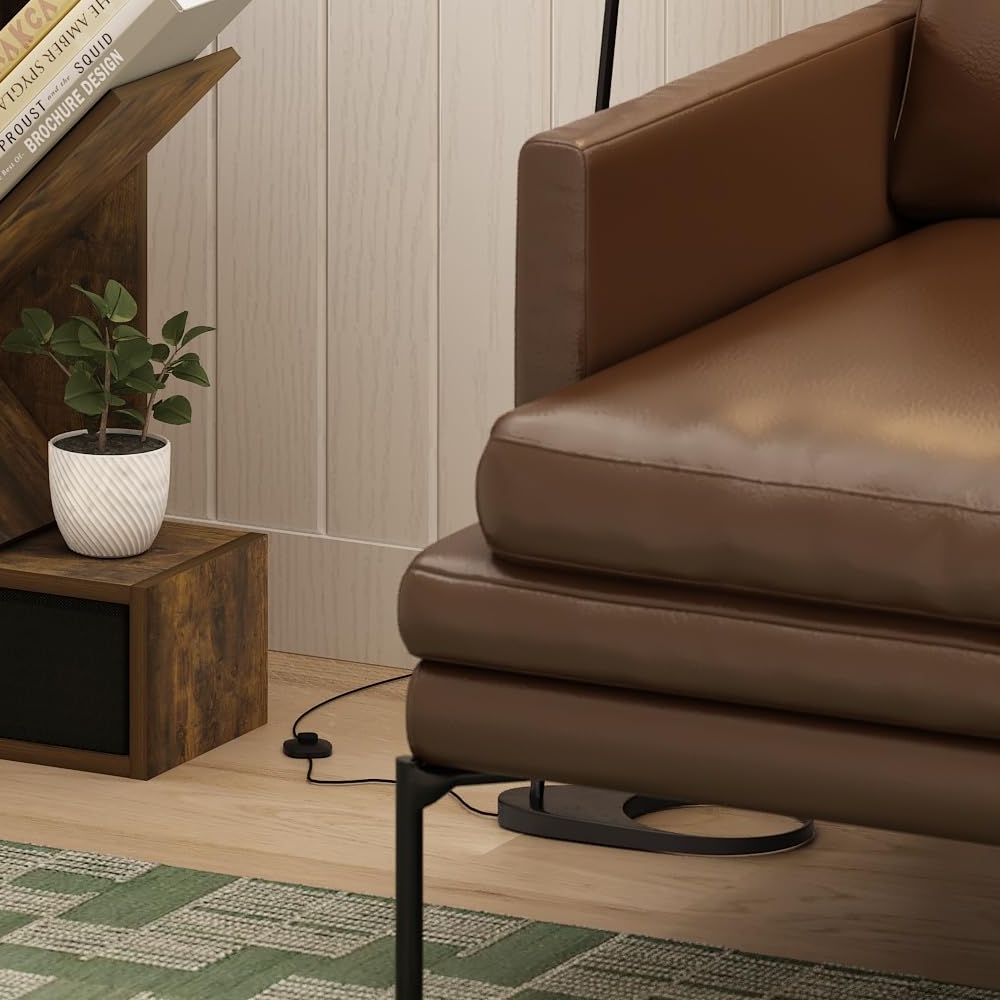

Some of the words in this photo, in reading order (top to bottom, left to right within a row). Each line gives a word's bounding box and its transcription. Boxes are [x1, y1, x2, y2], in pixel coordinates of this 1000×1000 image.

[42, 13, 89, 64] AMBER
[47, 85, 60, 101] and
[60, 75, 71, 88] the
[74, 33, 113, 75] SQUID
[23, 88, 85, 154] BROCHURE
[80, 48, 125, 95] DESIGN
